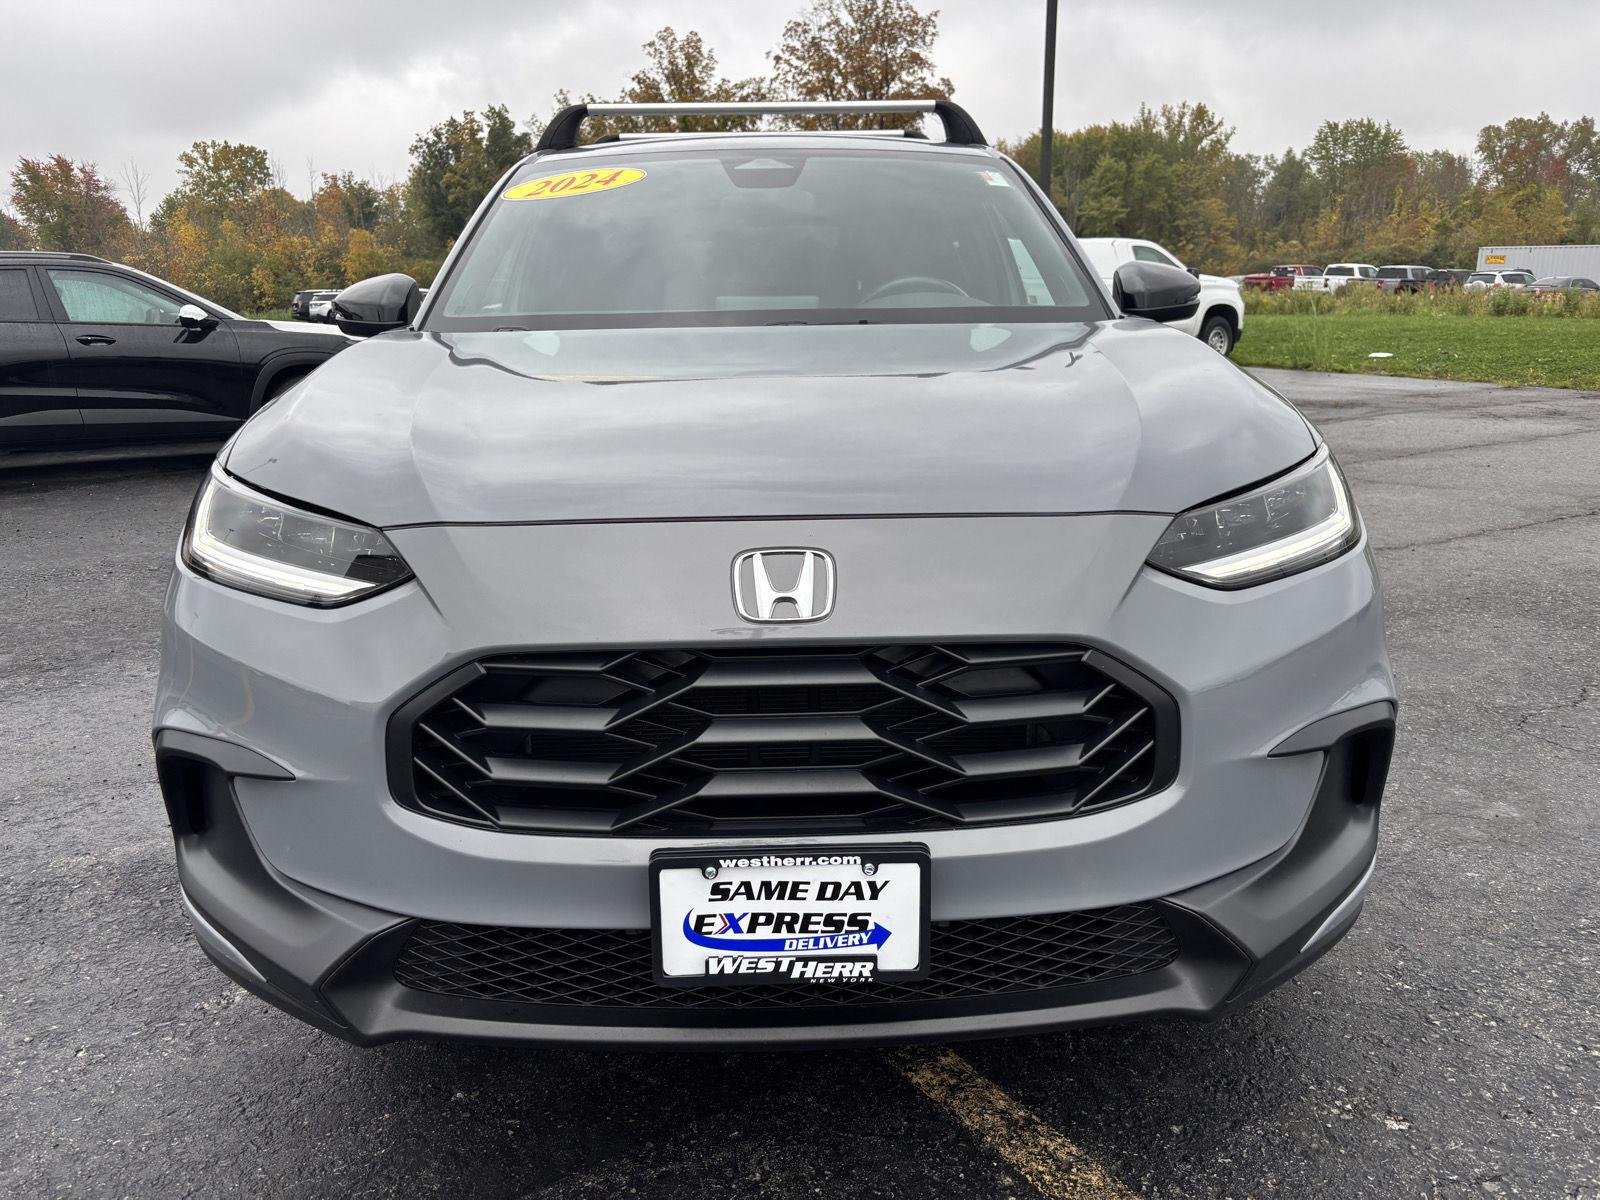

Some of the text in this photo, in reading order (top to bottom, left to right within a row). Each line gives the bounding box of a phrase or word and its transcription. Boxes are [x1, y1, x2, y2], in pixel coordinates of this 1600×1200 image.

[525, 170, 624, 197] 2024
[719, 855, 861, 868] westherr.com
[708, 880, 891, 902] SAME DAY
[693, 912, 873, 935] EXPRESS
[783, 931, 872, 951] DELIVERY
